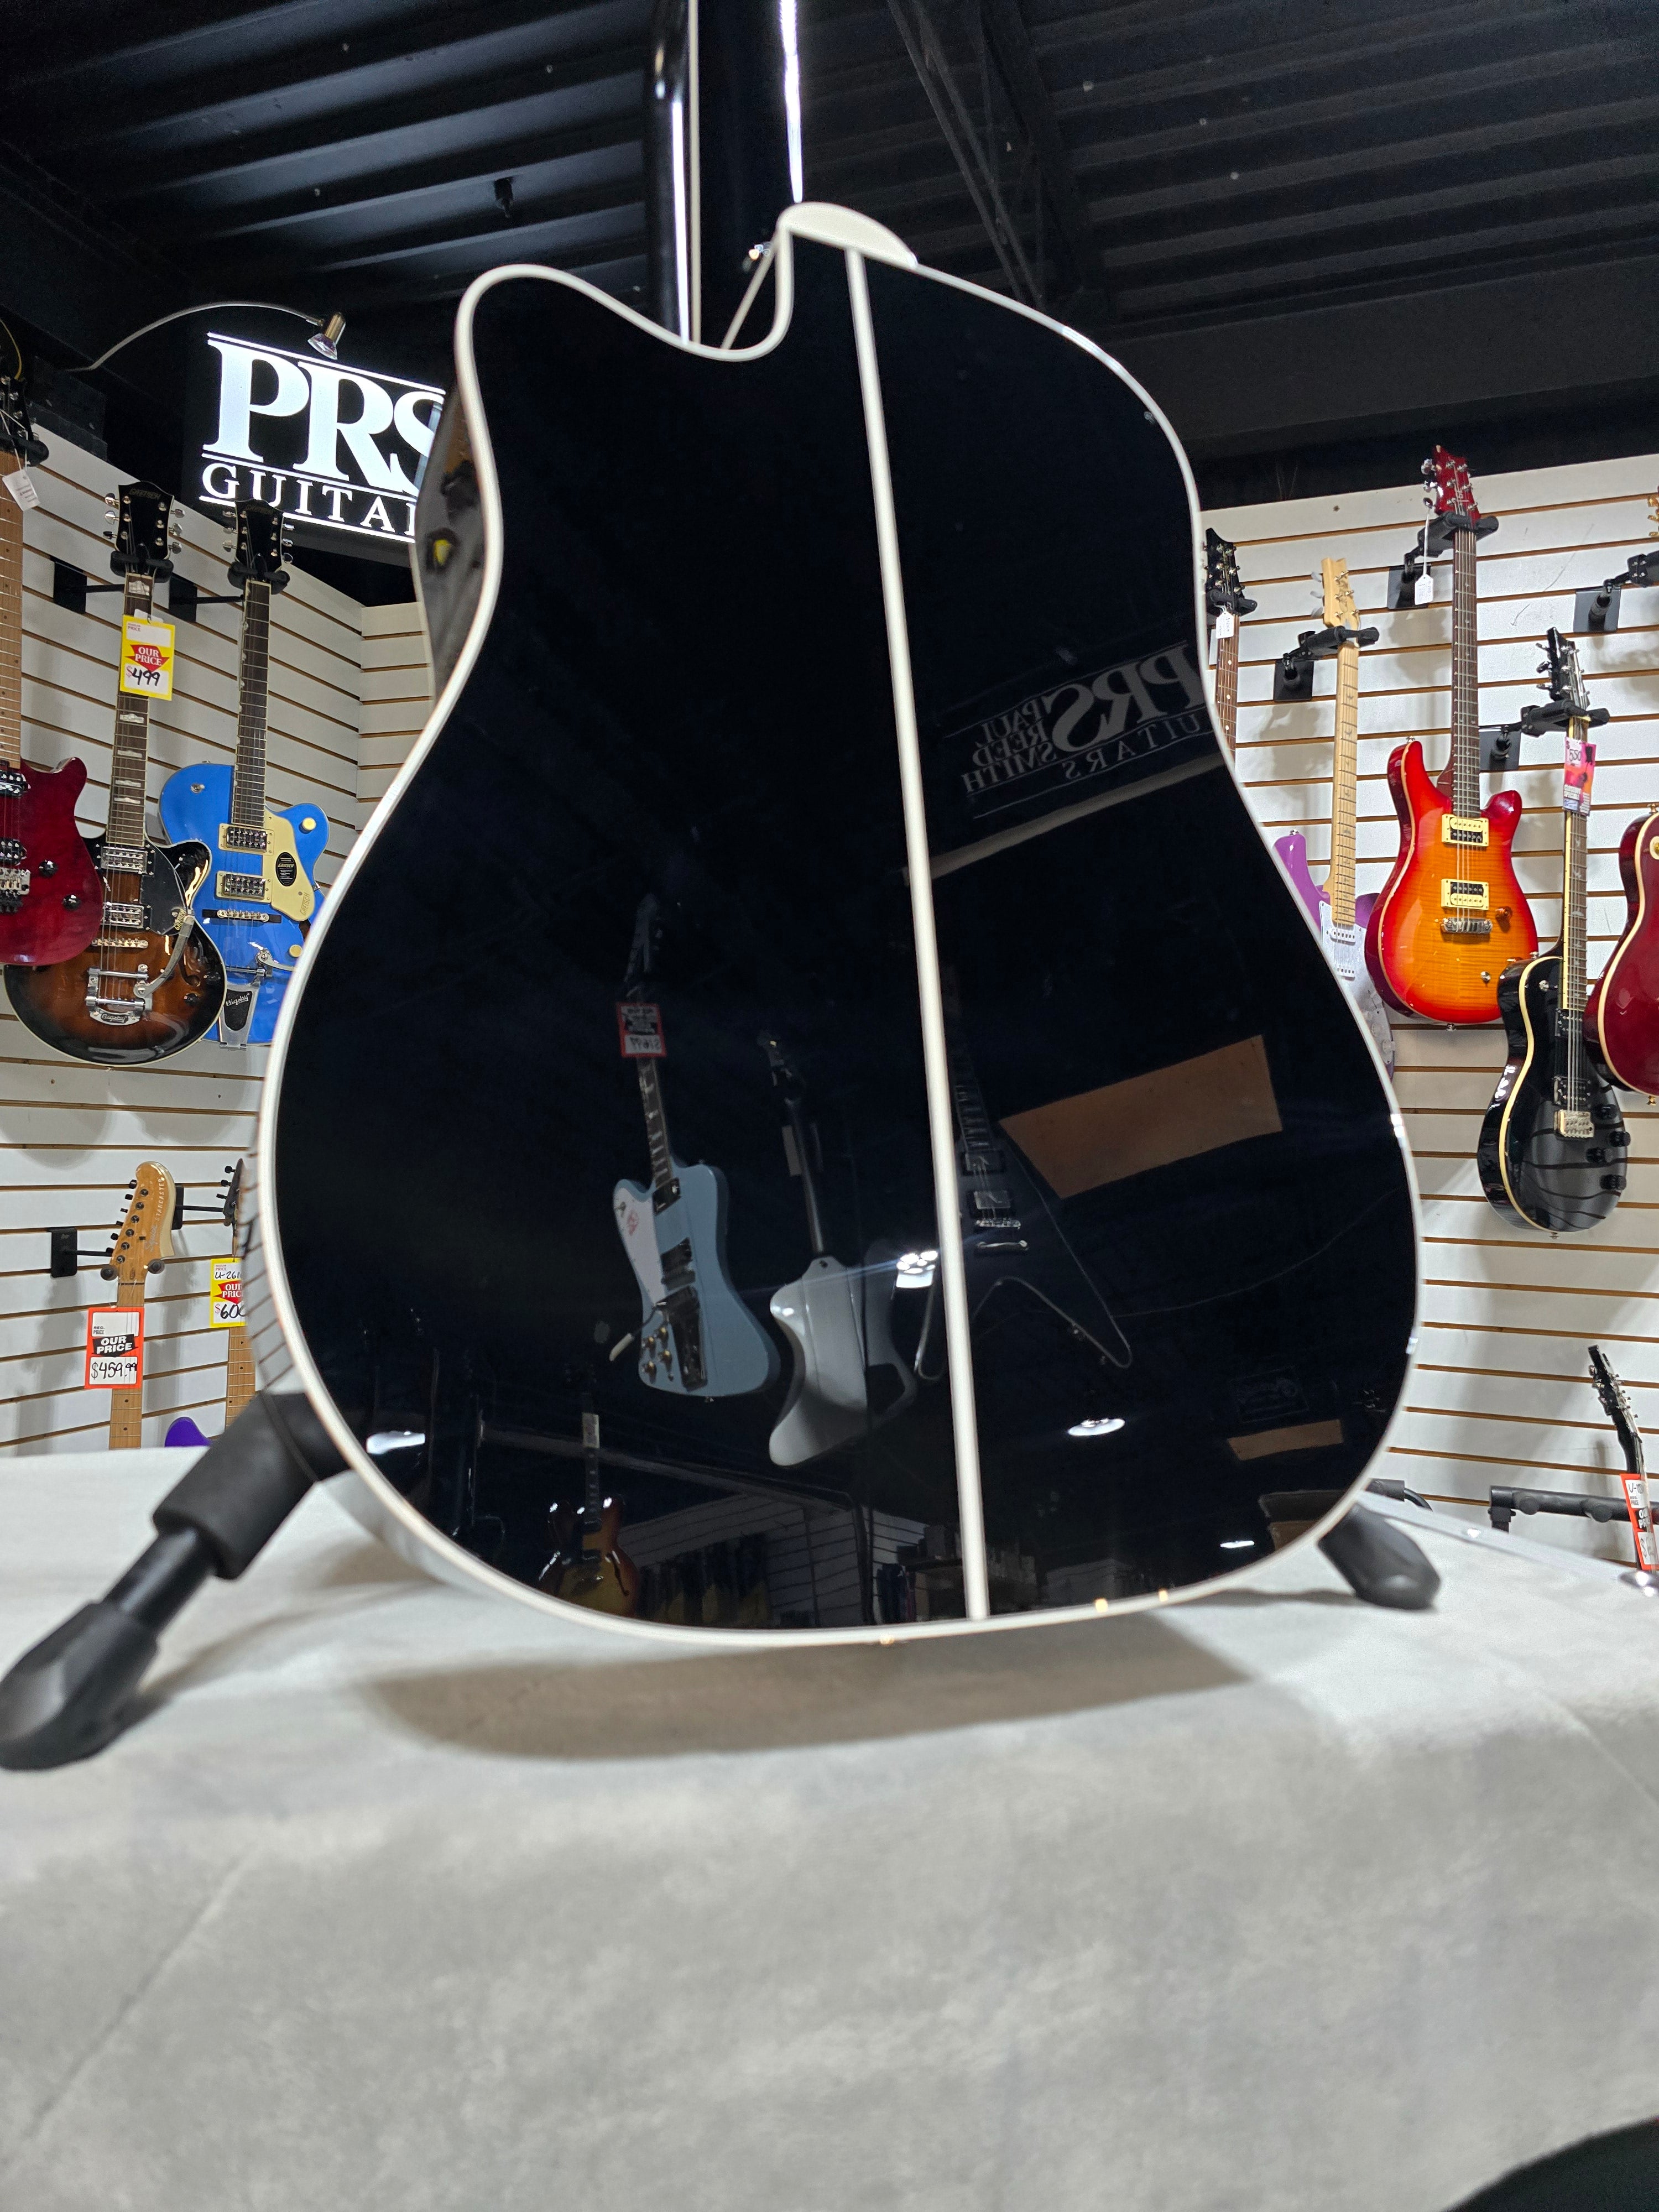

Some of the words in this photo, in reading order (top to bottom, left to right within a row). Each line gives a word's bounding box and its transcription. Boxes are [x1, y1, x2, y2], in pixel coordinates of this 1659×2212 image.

[203, 340, 445, 495] PRS
[138, 646, 159, 658] OUR
[134, 654, 162, 666] PRICE
[126, 665, 160, 687] $499
[300, 892, 310, 916] GRETSCH
[226, 994, 248, 1006] Bigsby
[102, 1014, 127, 1023] Bigsby
[222, 1290, 242, 1298] PRIC
[101, 1335, 127, 1346] OUR
[96, 1342, 133, 1354] PRICE
